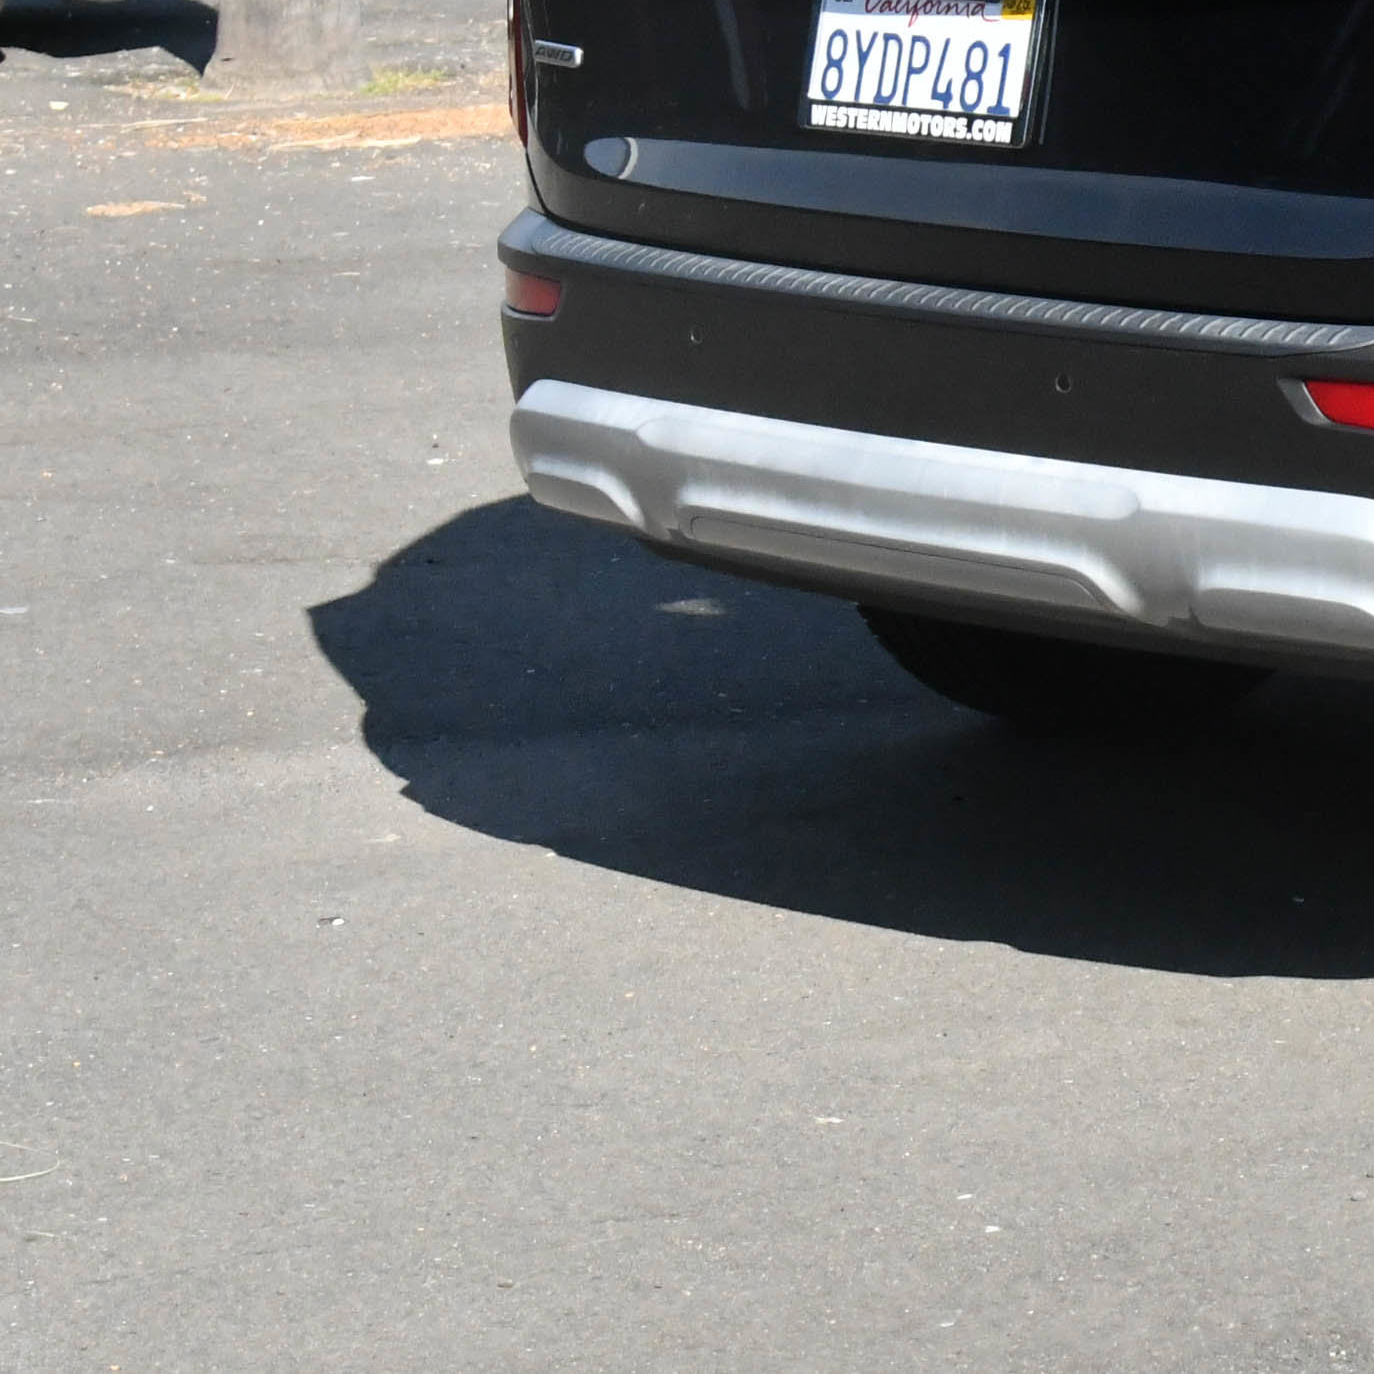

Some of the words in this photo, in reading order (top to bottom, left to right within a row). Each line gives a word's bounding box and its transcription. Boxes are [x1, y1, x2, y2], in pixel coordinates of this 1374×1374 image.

[535, 46, 574, 62] AWD
[820, 28, 1012, 116] 8YDP481
[810, 104, 1014, 144] WESTERNMOTORS.COM
